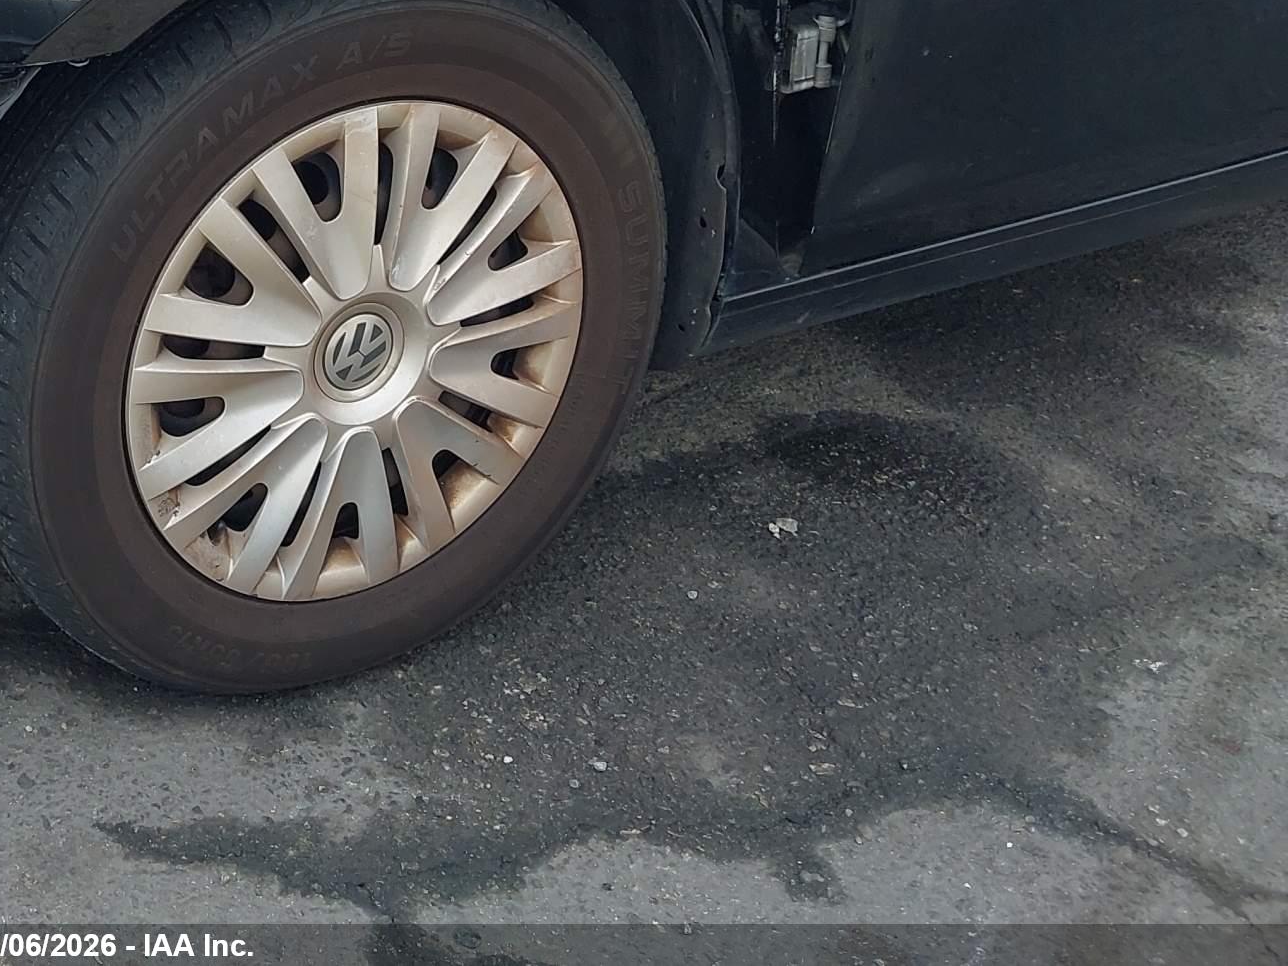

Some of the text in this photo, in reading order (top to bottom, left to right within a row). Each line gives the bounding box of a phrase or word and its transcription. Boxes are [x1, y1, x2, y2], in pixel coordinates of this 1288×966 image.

[113, 34, 410, 262] ULTRAMAX A/S
[327, 315, 391, 389] VW
[616, 180, 650, 395] SUMMIT
